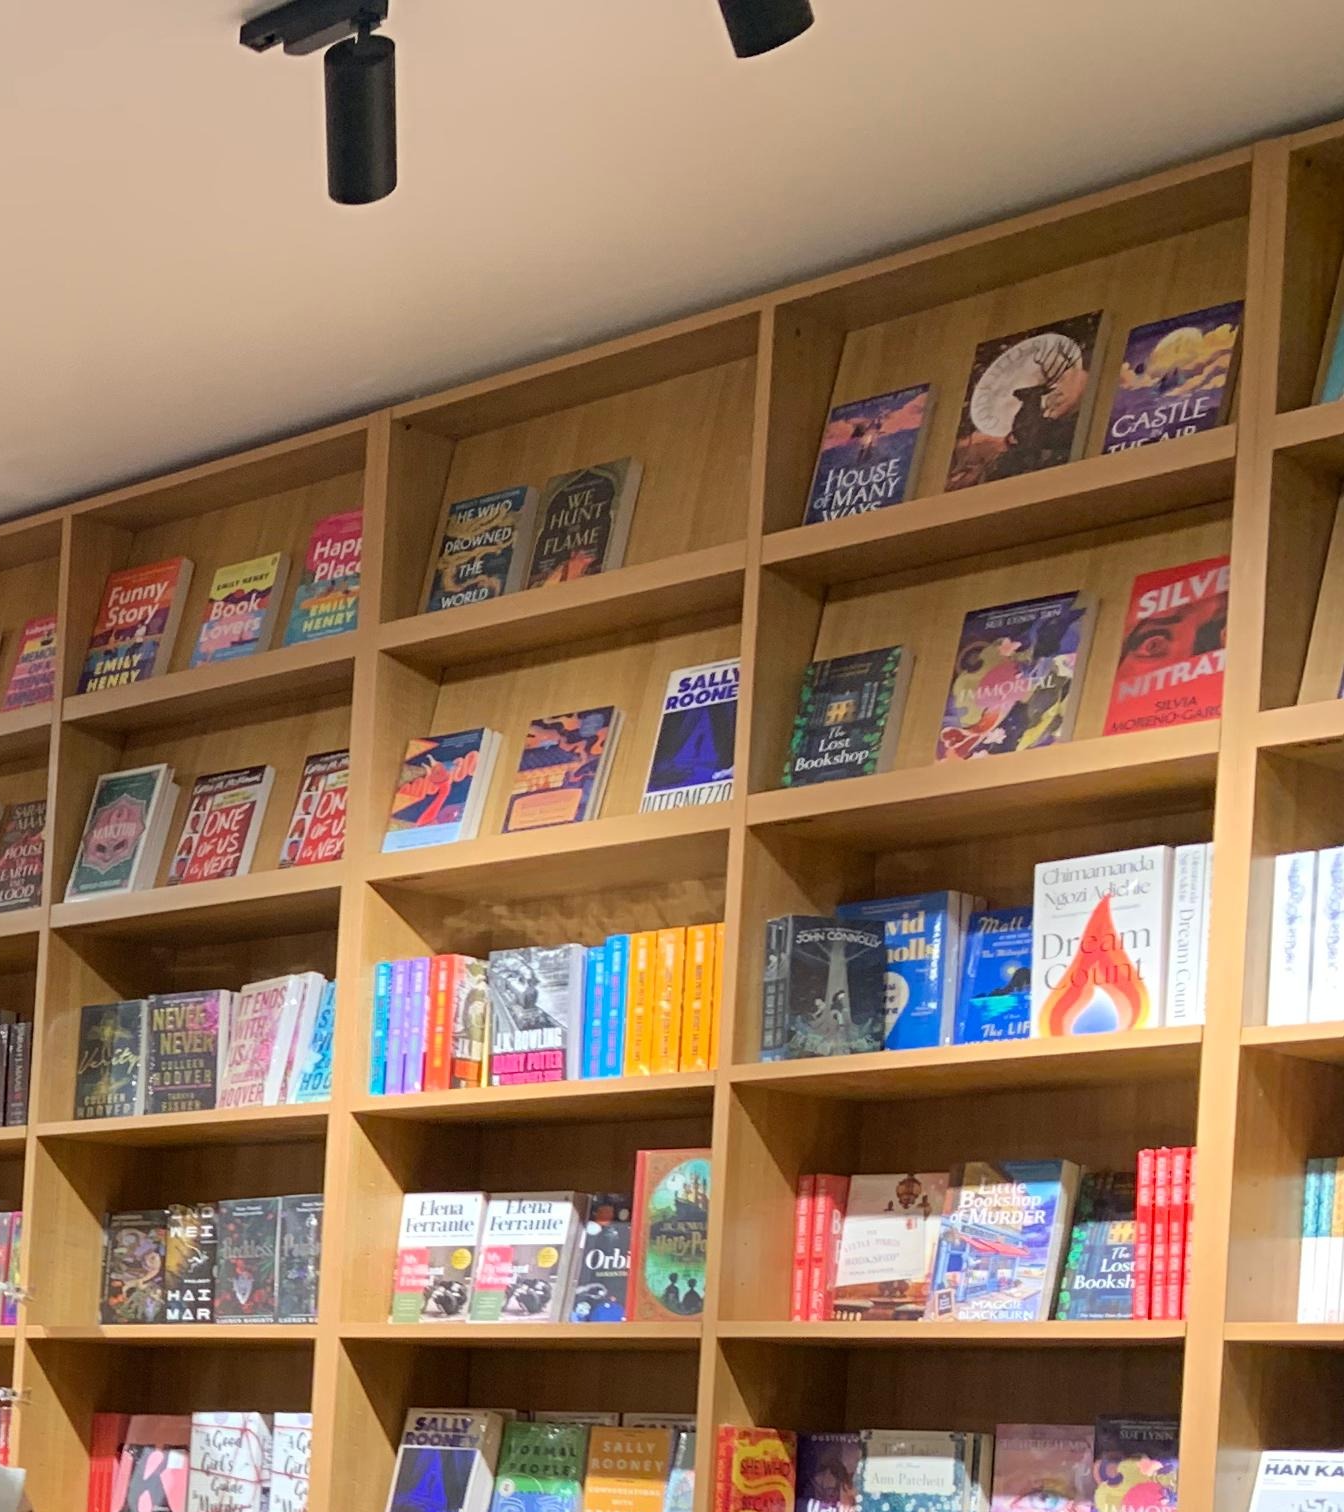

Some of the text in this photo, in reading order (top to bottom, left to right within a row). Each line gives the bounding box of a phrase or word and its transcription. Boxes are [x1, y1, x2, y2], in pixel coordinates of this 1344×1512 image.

[1111, 396, 1210, 438] CASTLE
[825, 457, 902, 491] HOUSE
[568, 490, 594, 508] WE
[829, 476, 903, 507] MANY
[478, 500, 512, 518] WHO
[550, 505, 605, 528] HUNT
[444, 528, 513, 554] DROWNED
[543, 528, 599, 555] FLAME
[459, 560, 484, 578] THE
[108, 580, 169, 607] Funny
[441, 587, 488, 608] WORLD
[106, 603, 160, 627] Story
[211, 596, 262, 621] Book
[302, 611, 355, 632] HENRY
[94, 653, 142, 675] EMILY
[86, 669, 140, 693] HENRY
[959, 674, 1057, 701] IMMORTAL
[829, 727, 846, 738] The
[818, 736, 851, 753] Lost
[794, 747, 870, 772] Bookshop
[203, 803, 251, 836] ONE
[218, 832, 241, 853] US
[0, 864, 39, 882] EARTH
[201, 853, 241, 877] NEXT
[1042, 853, 1154, 887] Chimamanda
[1044, 885, 1088, 910] Ngozi
[796, 931, 881, 948] JOHN CONNOLLY
[1040, 926, 1152, 960] Dream
[1177, 909, 1194, 964] Dream
[1043, 962, 1146, 993] Count
[252, 987, 287, 1012] ENDS
[161, 1031, 214, 1055] NEVER
[78, 1047, 143, 1074] Verity
[419, 1199, 464, 1217] Elena
[505, 1200, 553, 1217] Elena
[959, 1192, 1041, 1210] Bookshop
[406, 1216, 475, 1233] Ferrante
[490, 1216, 564, 1232] Ferrante
[951, 1208, 1045, 1225] of MURDER
[1112, 1248, 1130, 1260] The
[970, 1300, 1023, 1311] MAGGIE
[414, 1416, 475, 1432] SALLY
[602, 1440, 656, 1455] SALLY
[201, 1453, 234, 1473] Girl's
[591, 1456, 665, 1472] ROONEY
[1265, 1463, 1310, 1477] HAN
[871, 1472, 945, 1488] Ann Patchett
